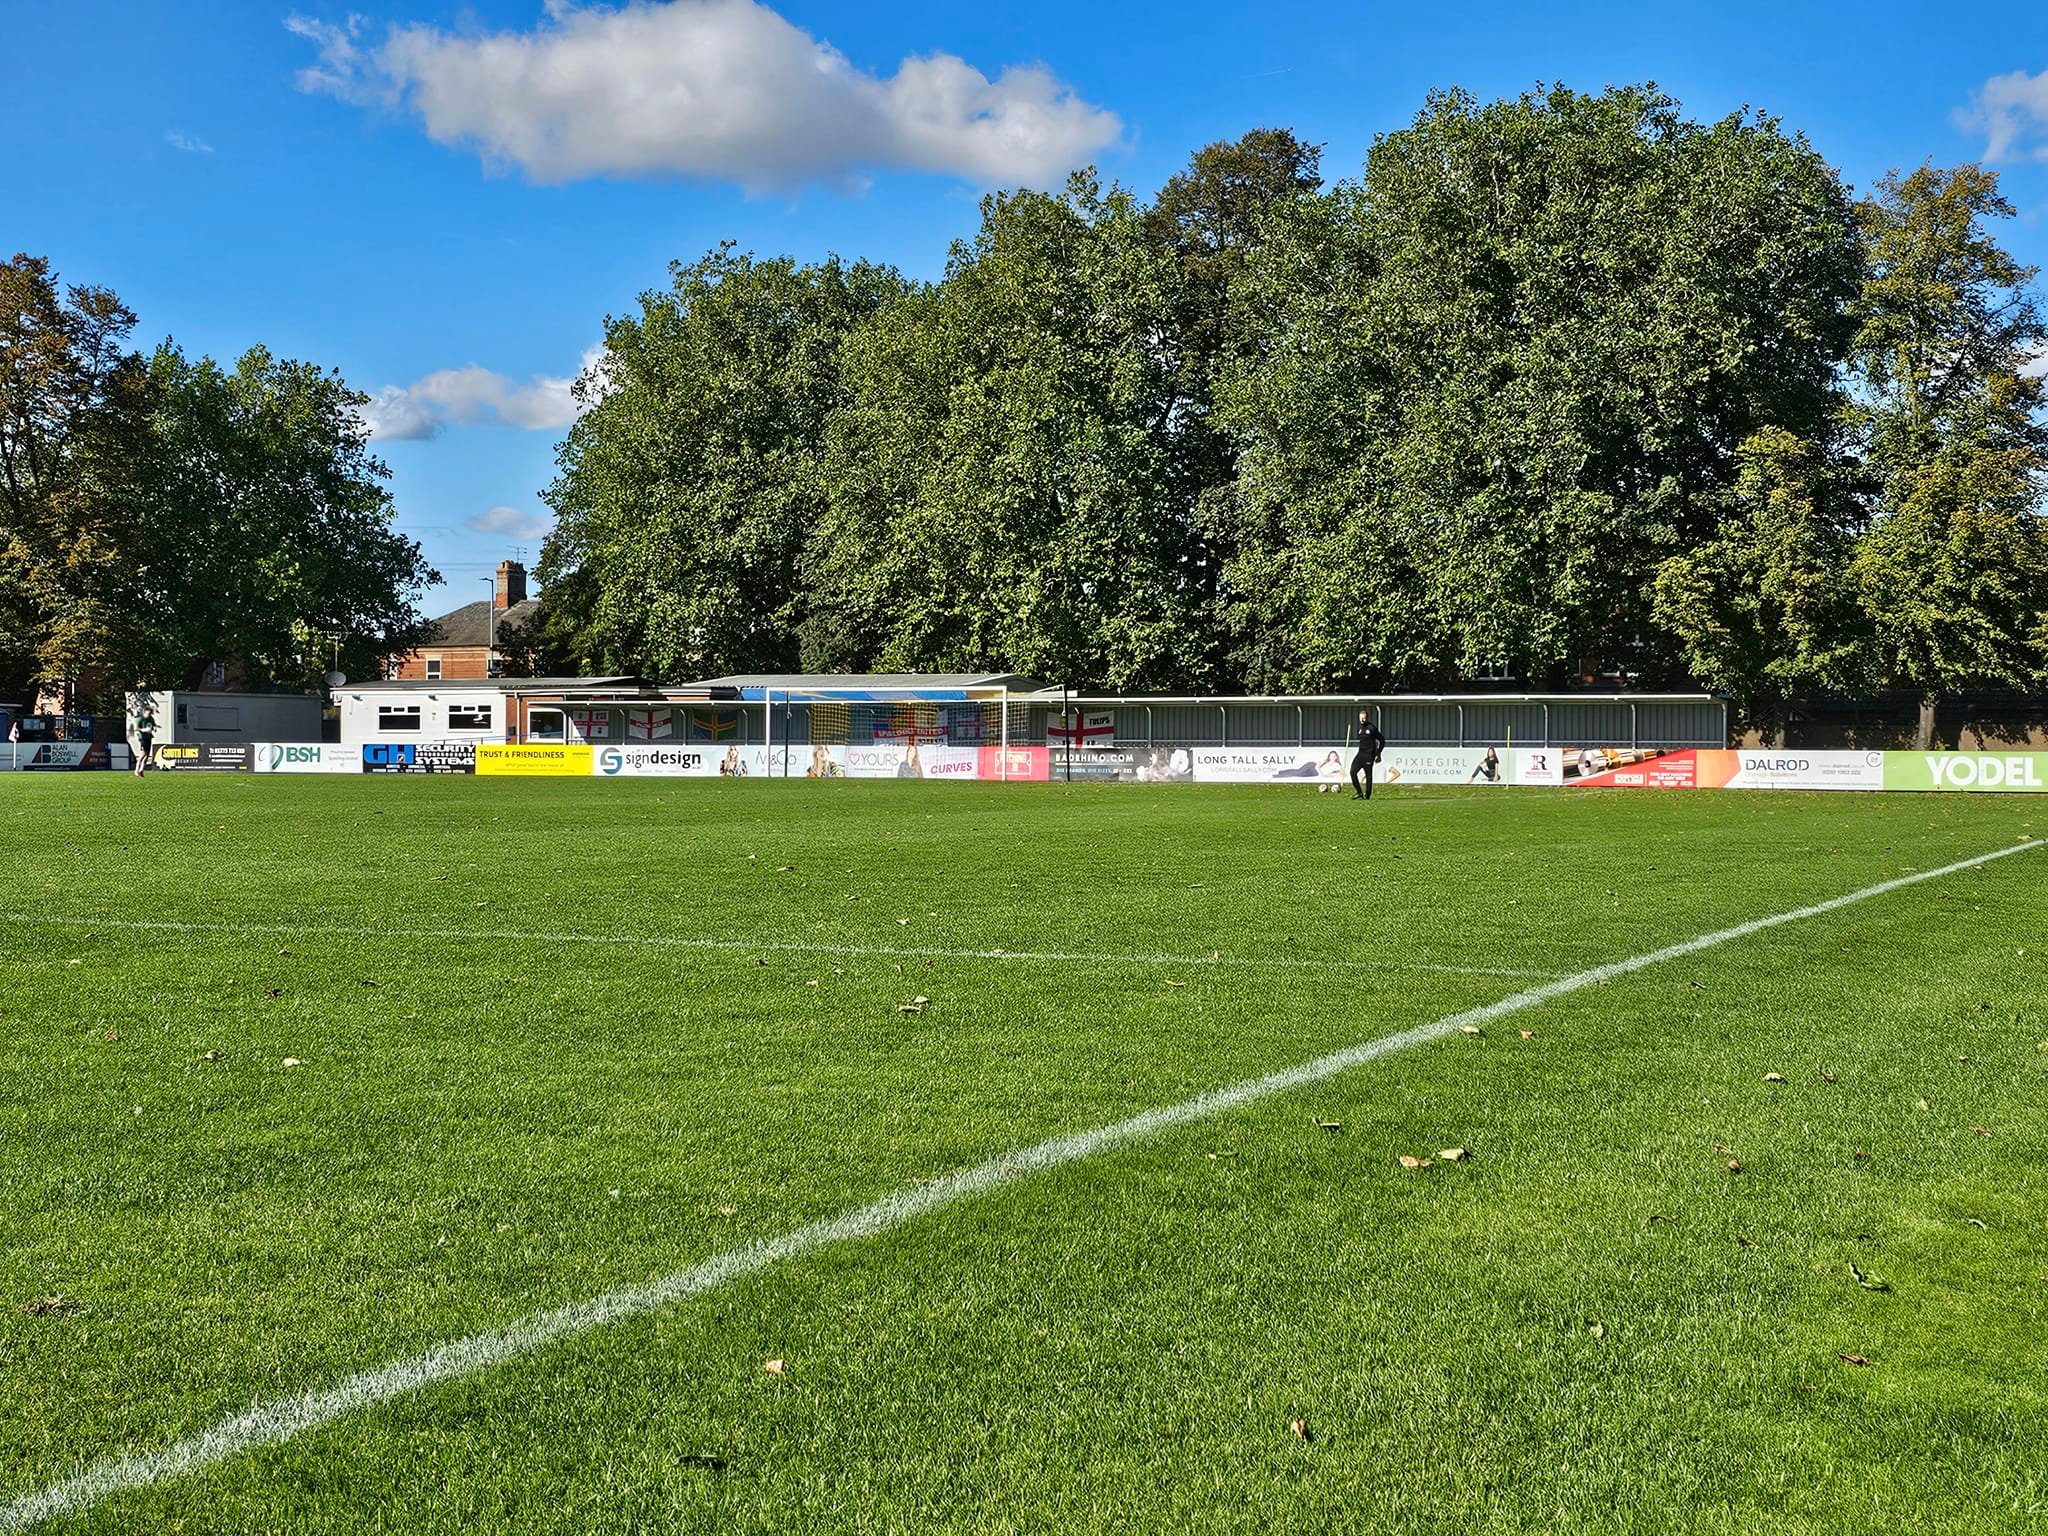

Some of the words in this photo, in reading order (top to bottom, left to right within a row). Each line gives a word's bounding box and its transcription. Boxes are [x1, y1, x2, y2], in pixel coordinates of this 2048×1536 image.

[1089, 716, 1110, 726] TULIPS
[286, 747, 320, 762] BSH
[363, 744, 415, 764] GH
[626, 750, 701, 768] signdesign
[862, 754, 899, 766] YOURS
[1198, 756, 1227, 764] LONG
[1231, 756, 1257, 764] TALL
[1262, 756, 1295, 764] SALLY
[415, 757, 475, 765] SYSTEMS
[1396, 758, 1467, 767] PIXIEGIRL
[1746, 759, 1809, 771] DALROD
[931, 762, 973, 774] CURVES
[1925, 756, 2042, 786] YODEL
